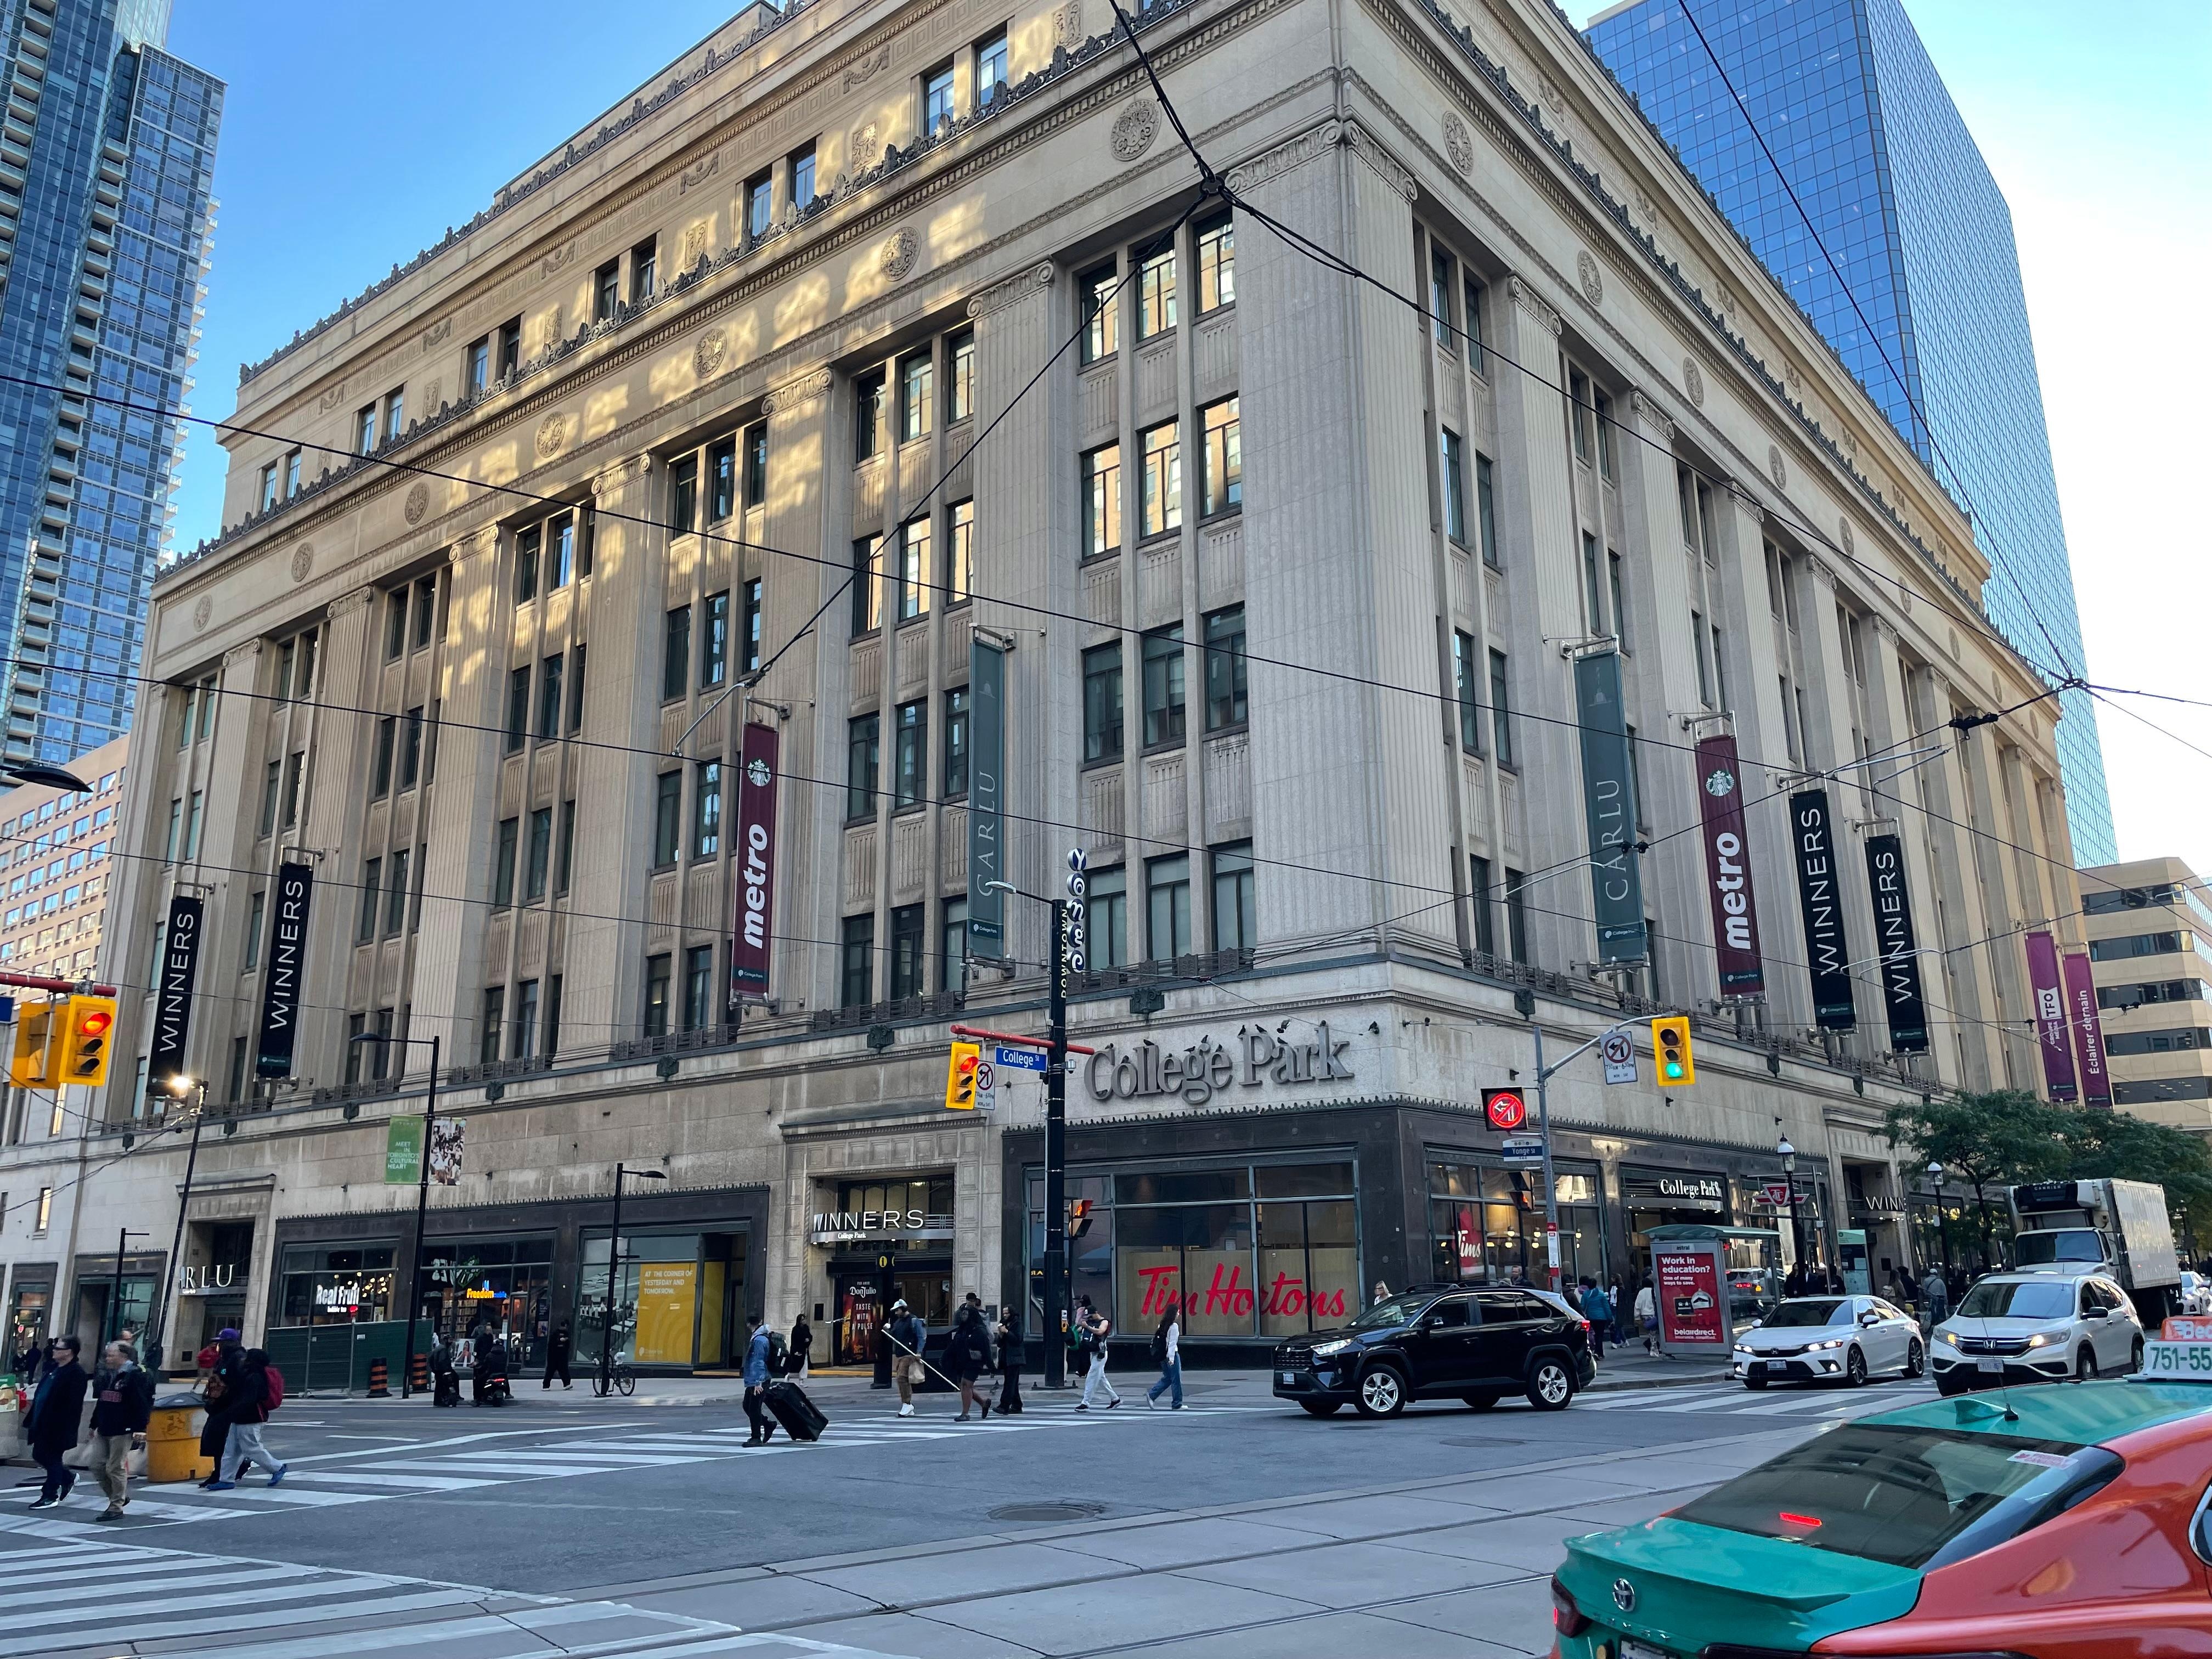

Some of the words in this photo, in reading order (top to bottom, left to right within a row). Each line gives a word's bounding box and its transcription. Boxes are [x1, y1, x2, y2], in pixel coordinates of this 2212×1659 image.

[977, 771, 996, 896] CARLU
[1596, 780, 1628, 901] CARLU
[743, 824, 768, 949] metro
[1716, 832, 1751, 950] metro
[1801, 808, 1838, 975] WINNERS
[1071, 848, 1085, 974] Yonge
[1876, 852, 1912, 1003] WINNERS
[269, 880, 303, 1029] WINNERS
[159, 913, 194, 1052] WINNERS
[2044, 993, 2056, 1017] TFO
[2078, 990, 2093, 1032] demain
[1003, 1049, 1034, 1068] College
[1084, 1042, 1233, 1105] College
[1237, 1024, 1355, 1086] Park
[2086, 1034, 2100, 1074] Éclairer
[1660, 1179, 1699, 1199] College
[1700, 1180, 1716, 1196] Park
[1865, 1196, 1907, 1211] WINN
[1458, 1229, 1481, 1258] Tims
[1661, 1256, 1685, 1265] Work
[1686, 1256, 1696, 1265] in
[1138, 1266, 1198, 1316] Tim
[1205, 1263, 1345, 1317] Hortons
[1662, 1265, 1711, 1273] education?
[316, 1284, 338, 1305] Real
[467, 1288, 494, 1299] Freedom
[857, 1322, 873, 1330] PULSE
